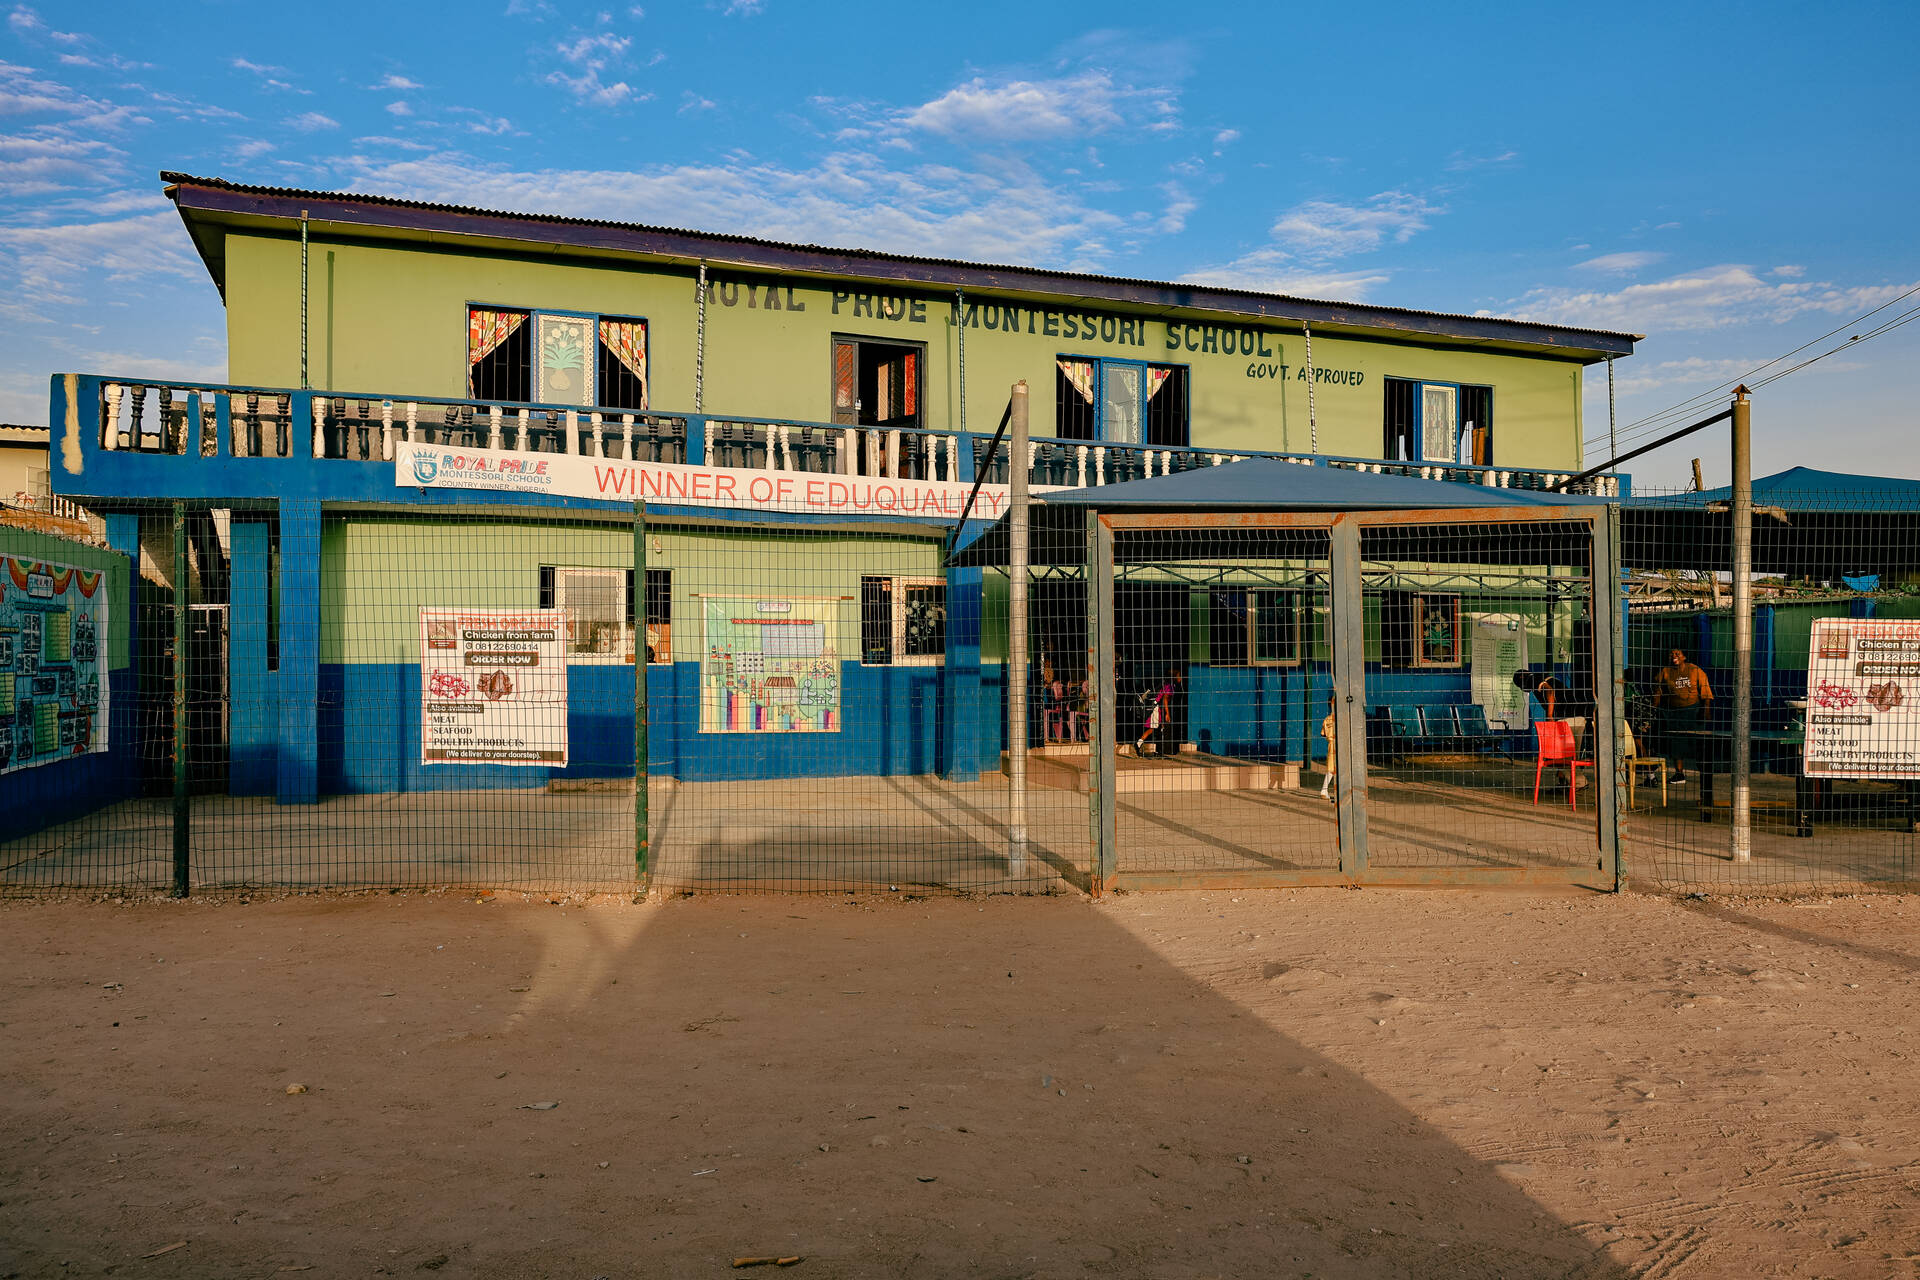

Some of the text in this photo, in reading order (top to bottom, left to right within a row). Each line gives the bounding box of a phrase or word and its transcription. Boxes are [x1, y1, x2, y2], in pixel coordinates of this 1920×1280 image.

[694, 277, 1273, 358] ROYAL PRIDE MONTESSORI SCHOOL
[1246, 362, 1291, 381] GOVT.
[442, 456, 548, 475] ROYAL PRIDE
[440, 471, 552, 485] MONTESSORI SCHOOLS
[438, 480, 478, 489] (COUNTRY
[479, 483, 510, 491] WINNER
[516, 485, 549, 494] NIGERIA)
[595, 465, 1005, 515] WINNER OF EDUQUALITY
[457, 617, 560, 630] FRESH ORGANIC
[465, 631, 504, 640] Chicken
[506, 632, 529, 640] from
[531, 632, 554, 640] farm
[1852, 626, 1893, 639] FRESH
[475, 643, 539, 651] 08122690414
[1859, 640, 1920, 650] Chicken fro
[470, 655, 531, 664] ORDER NOW
[1863, 665, 1899, 674] ORDER
[430, 704, 447, 712] Also
[432, 716, 456, 724] MEAT
[433, 727, 473, 735] SEAFOOD
[1816, 728, 1842, 736] MEAT
[434, 738, 525, 747] POULTRY PRODUCTS
[1816, 739, 1858, 747] SEAFOOD
[460, 750, 483, 758] deliver
[1816, 750, 1913, 760] POULTRY PRODUCTS
[1843, 763, 1868, 771] deliver
